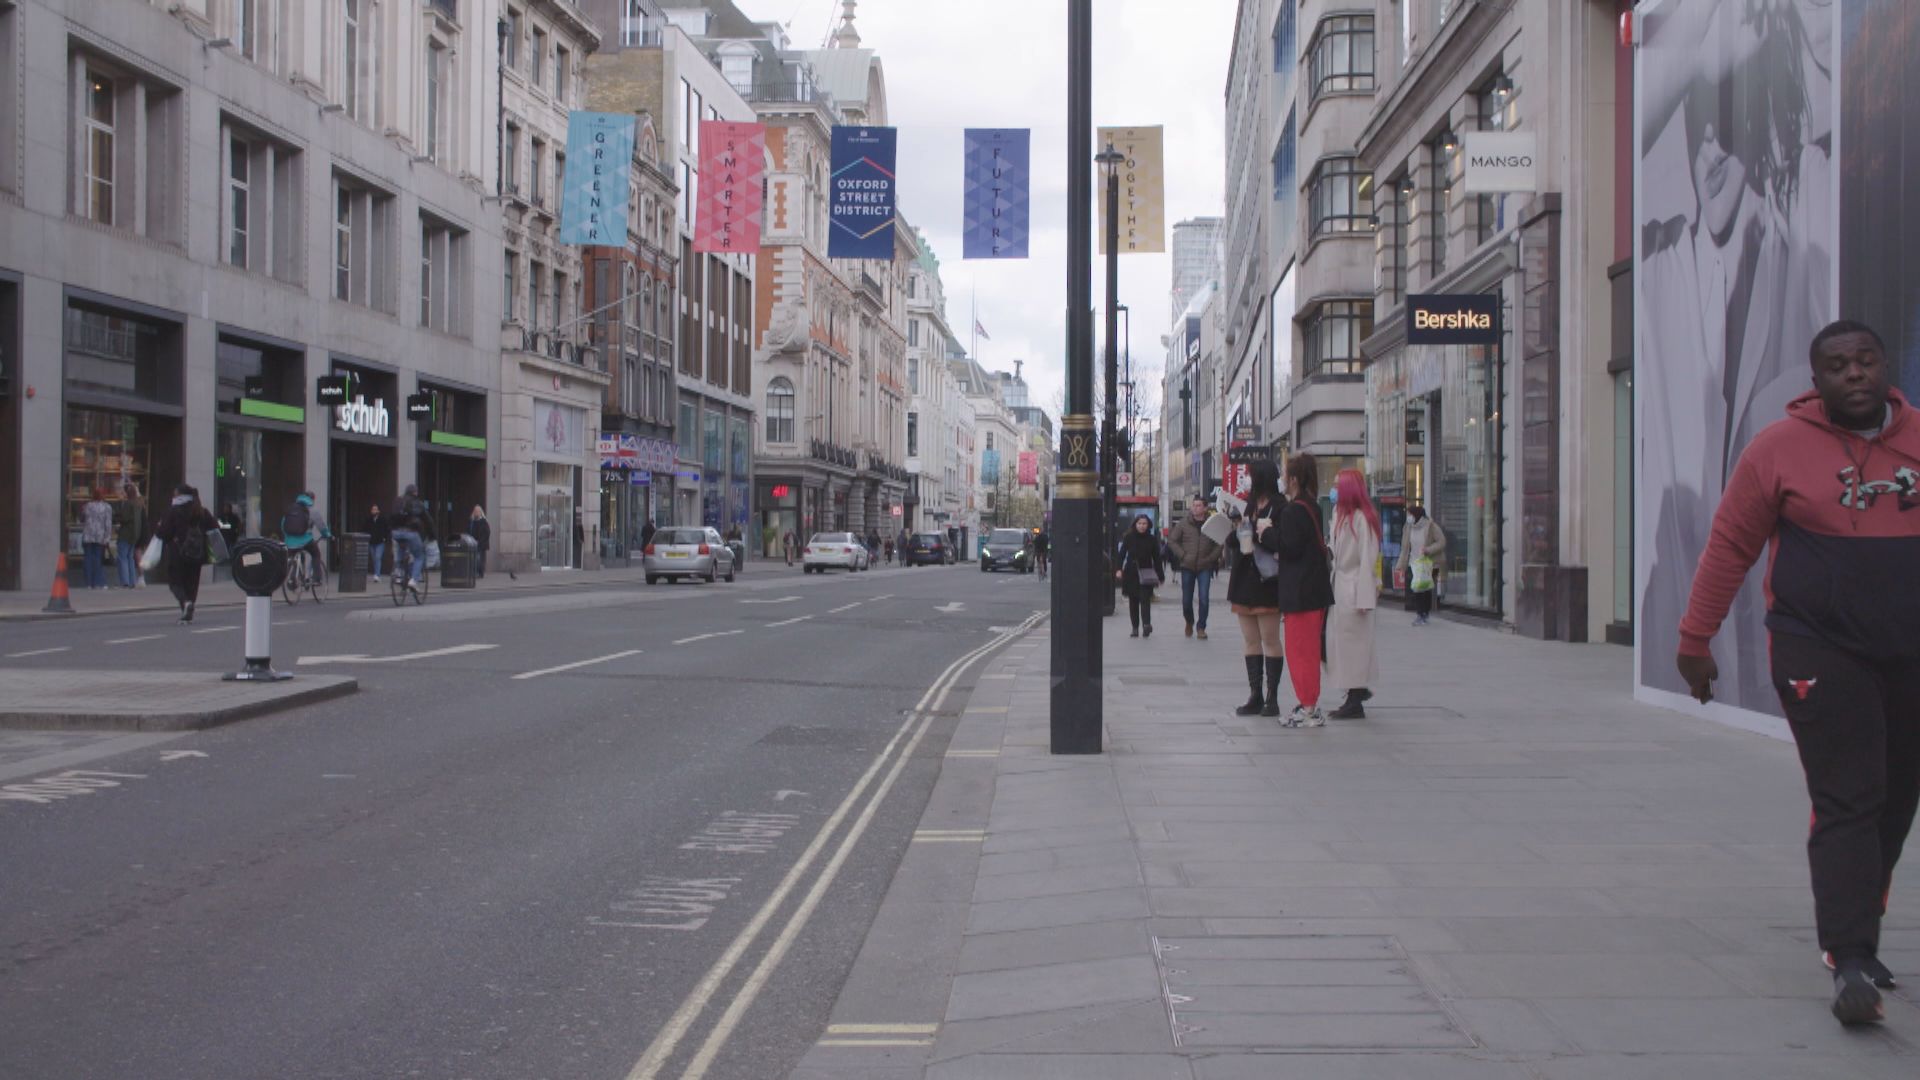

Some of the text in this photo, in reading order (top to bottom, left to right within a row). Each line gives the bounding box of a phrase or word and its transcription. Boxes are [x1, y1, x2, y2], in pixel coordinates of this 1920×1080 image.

[1471, 155, 1532, 168] MANGO
[589, 131, 605, 240] GREENER
[837, 179, 889, 190] OXFORD
[723, 140, 737, 248] SMARTER
[839, 192, 886, 203] STREET
[991, 147, 1001, 257] FUTURE
[1125, 144, 1136, 250] TOGETHER
[834, 205, 891, 216] DISTRICT
[1415, 309, 1490, 329] Bershka
[320, 386, 343, 396] schuh
[340, 394, 389, 437] schuh
[410, 403, 430, 412] schuh
